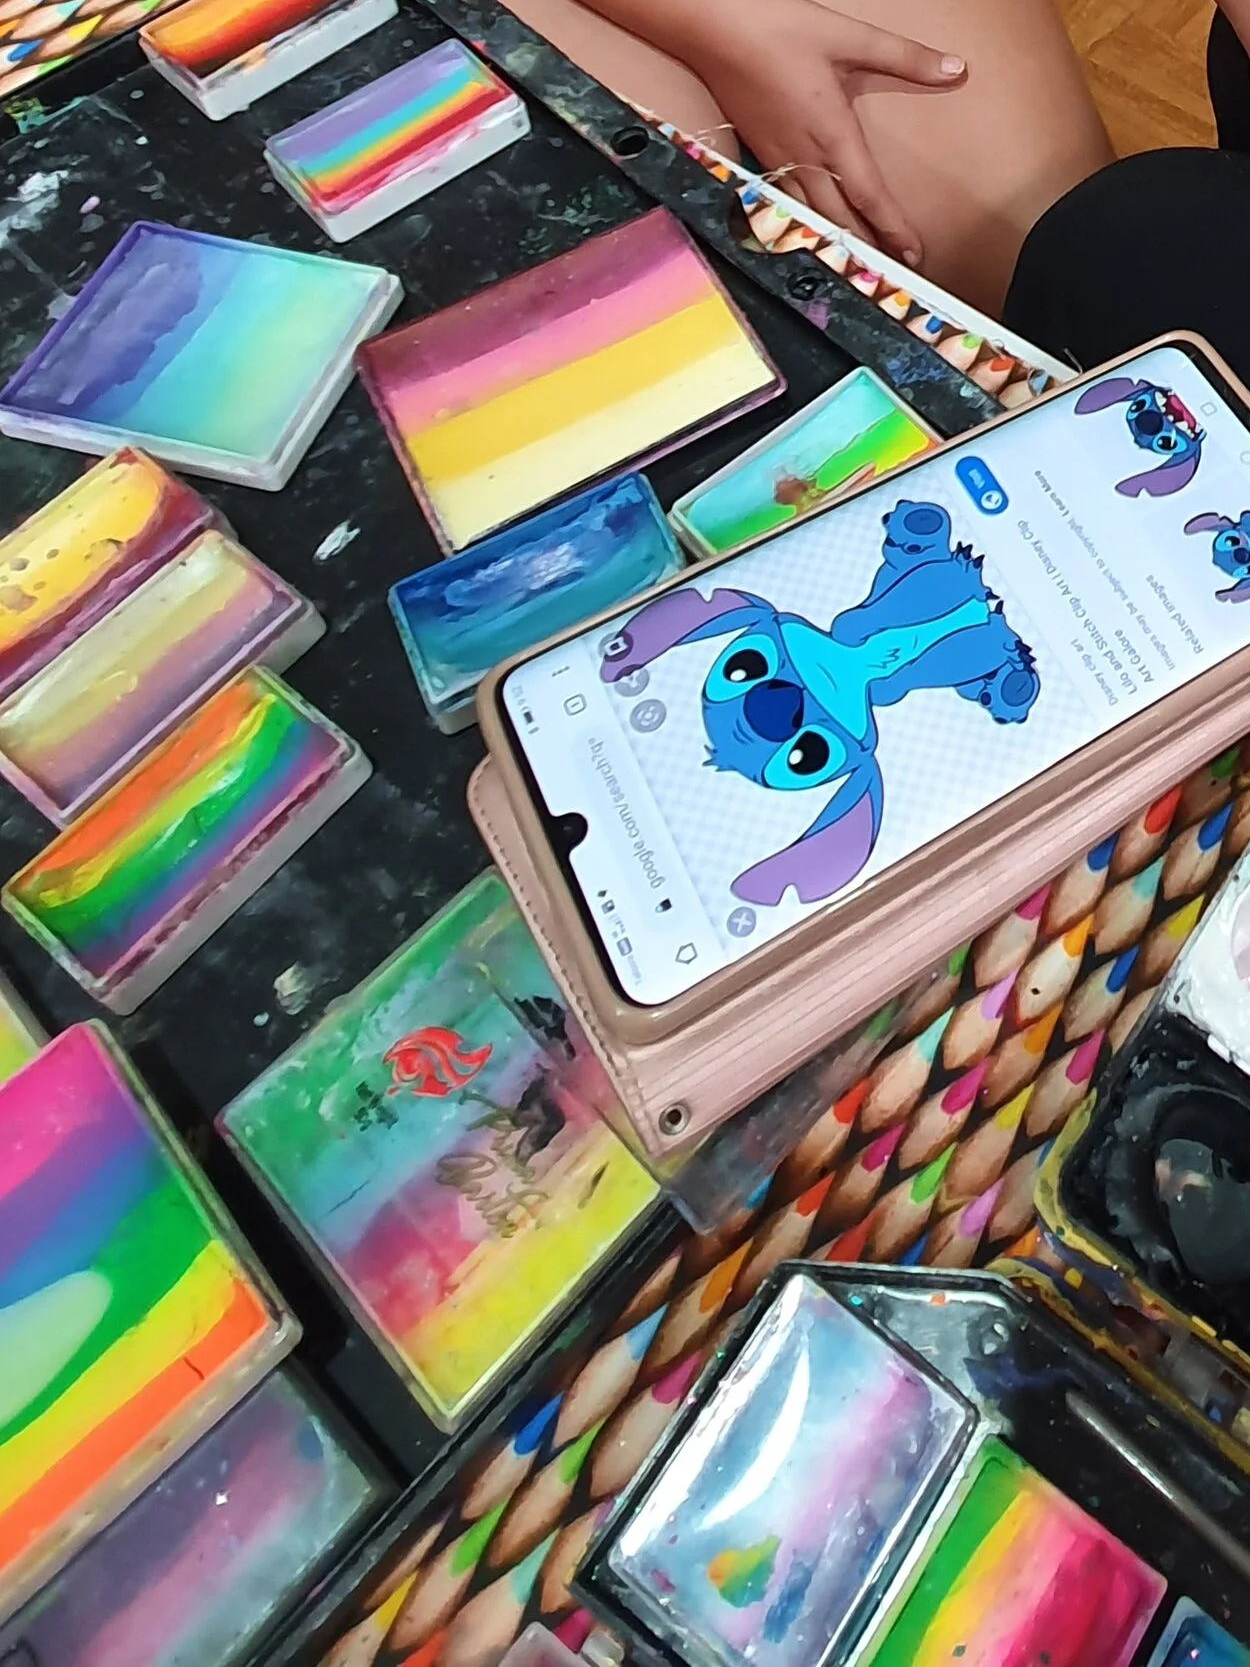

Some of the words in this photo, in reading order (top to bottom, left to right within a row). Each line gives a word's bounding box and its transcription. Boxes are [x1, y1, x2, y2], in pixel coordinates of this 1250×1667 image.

[1034, 470, 1052, 493] More
[1049, 491, 1070, 518] Learn
[1016, 519, 1035, 541] Clip
[1030, 539, 1058, 575] Disney
[1095, 557, 1106, 570] to
[1056, 578, 1073, 596] Art
[1101, 567, 1129, 602] subject
[1145, 574, 1176, 614] images
[1068, 596, 1087, 619] Clip
[1125, 601, 1138, 616] be
[1083, 617, 1109, 651] Stitch
[1135, 614, 1152, 635] may
[1169, 612, 1205, 655] Related
[1070, 637, 1085, 653] art
[1114, 629, 1142, 666] Galore
[1149, 633, 1176, 671] Images
[1081, 653, 1097, 672] clip
[1101, 649, 1124, 672] and
[1119, 671, 1138, 696] Lilo
[1137, 663, 1155, 683] Art
[1093, 671, 1119, 707] Disney
